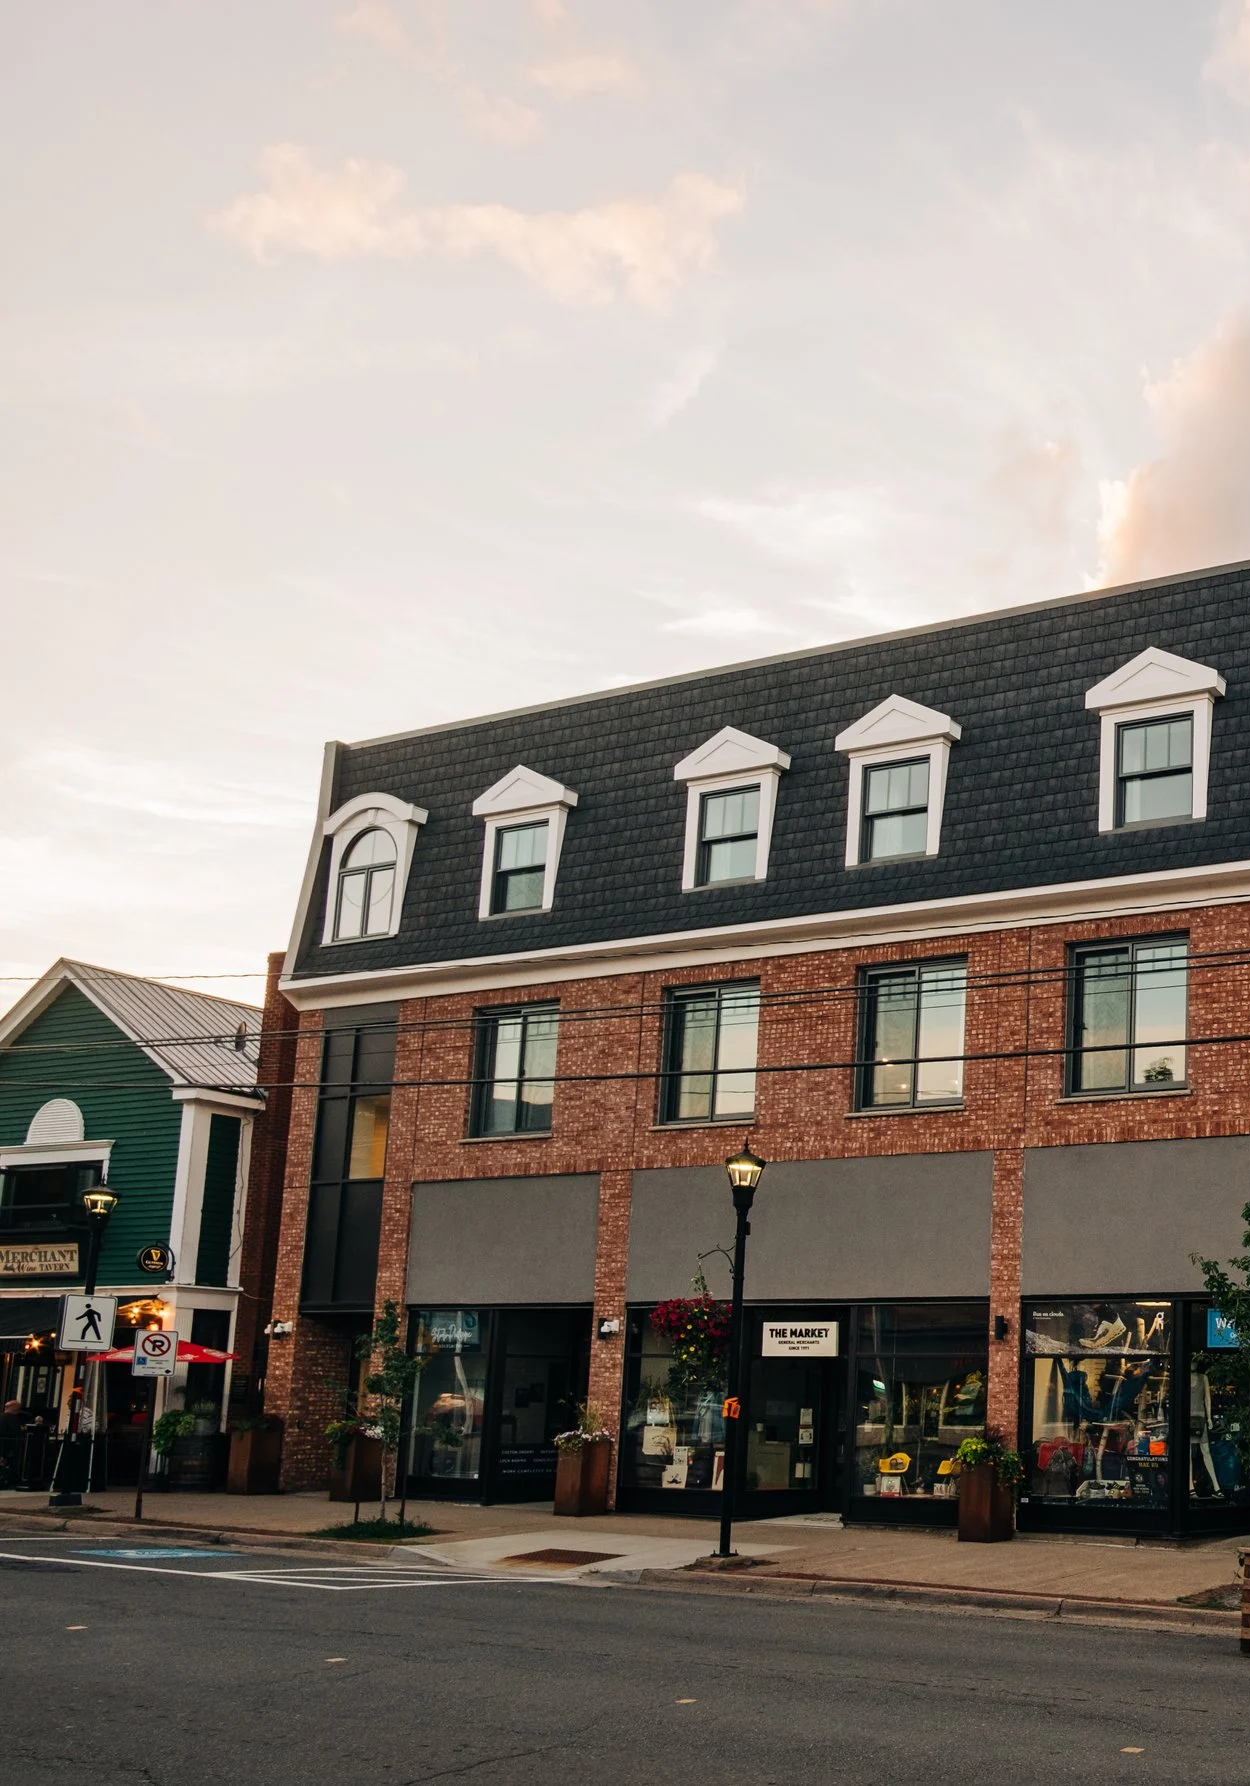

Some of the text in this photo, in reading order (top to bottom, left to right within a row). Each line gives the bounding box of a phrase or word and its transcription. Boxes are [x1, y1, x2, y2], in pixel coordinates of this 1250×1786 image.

[0, 1249, 77, 1264] MERCHANT
[39, 1262, 70, 1271] TAVERN
[769, 1328, 829, 1338] THE MARKET
